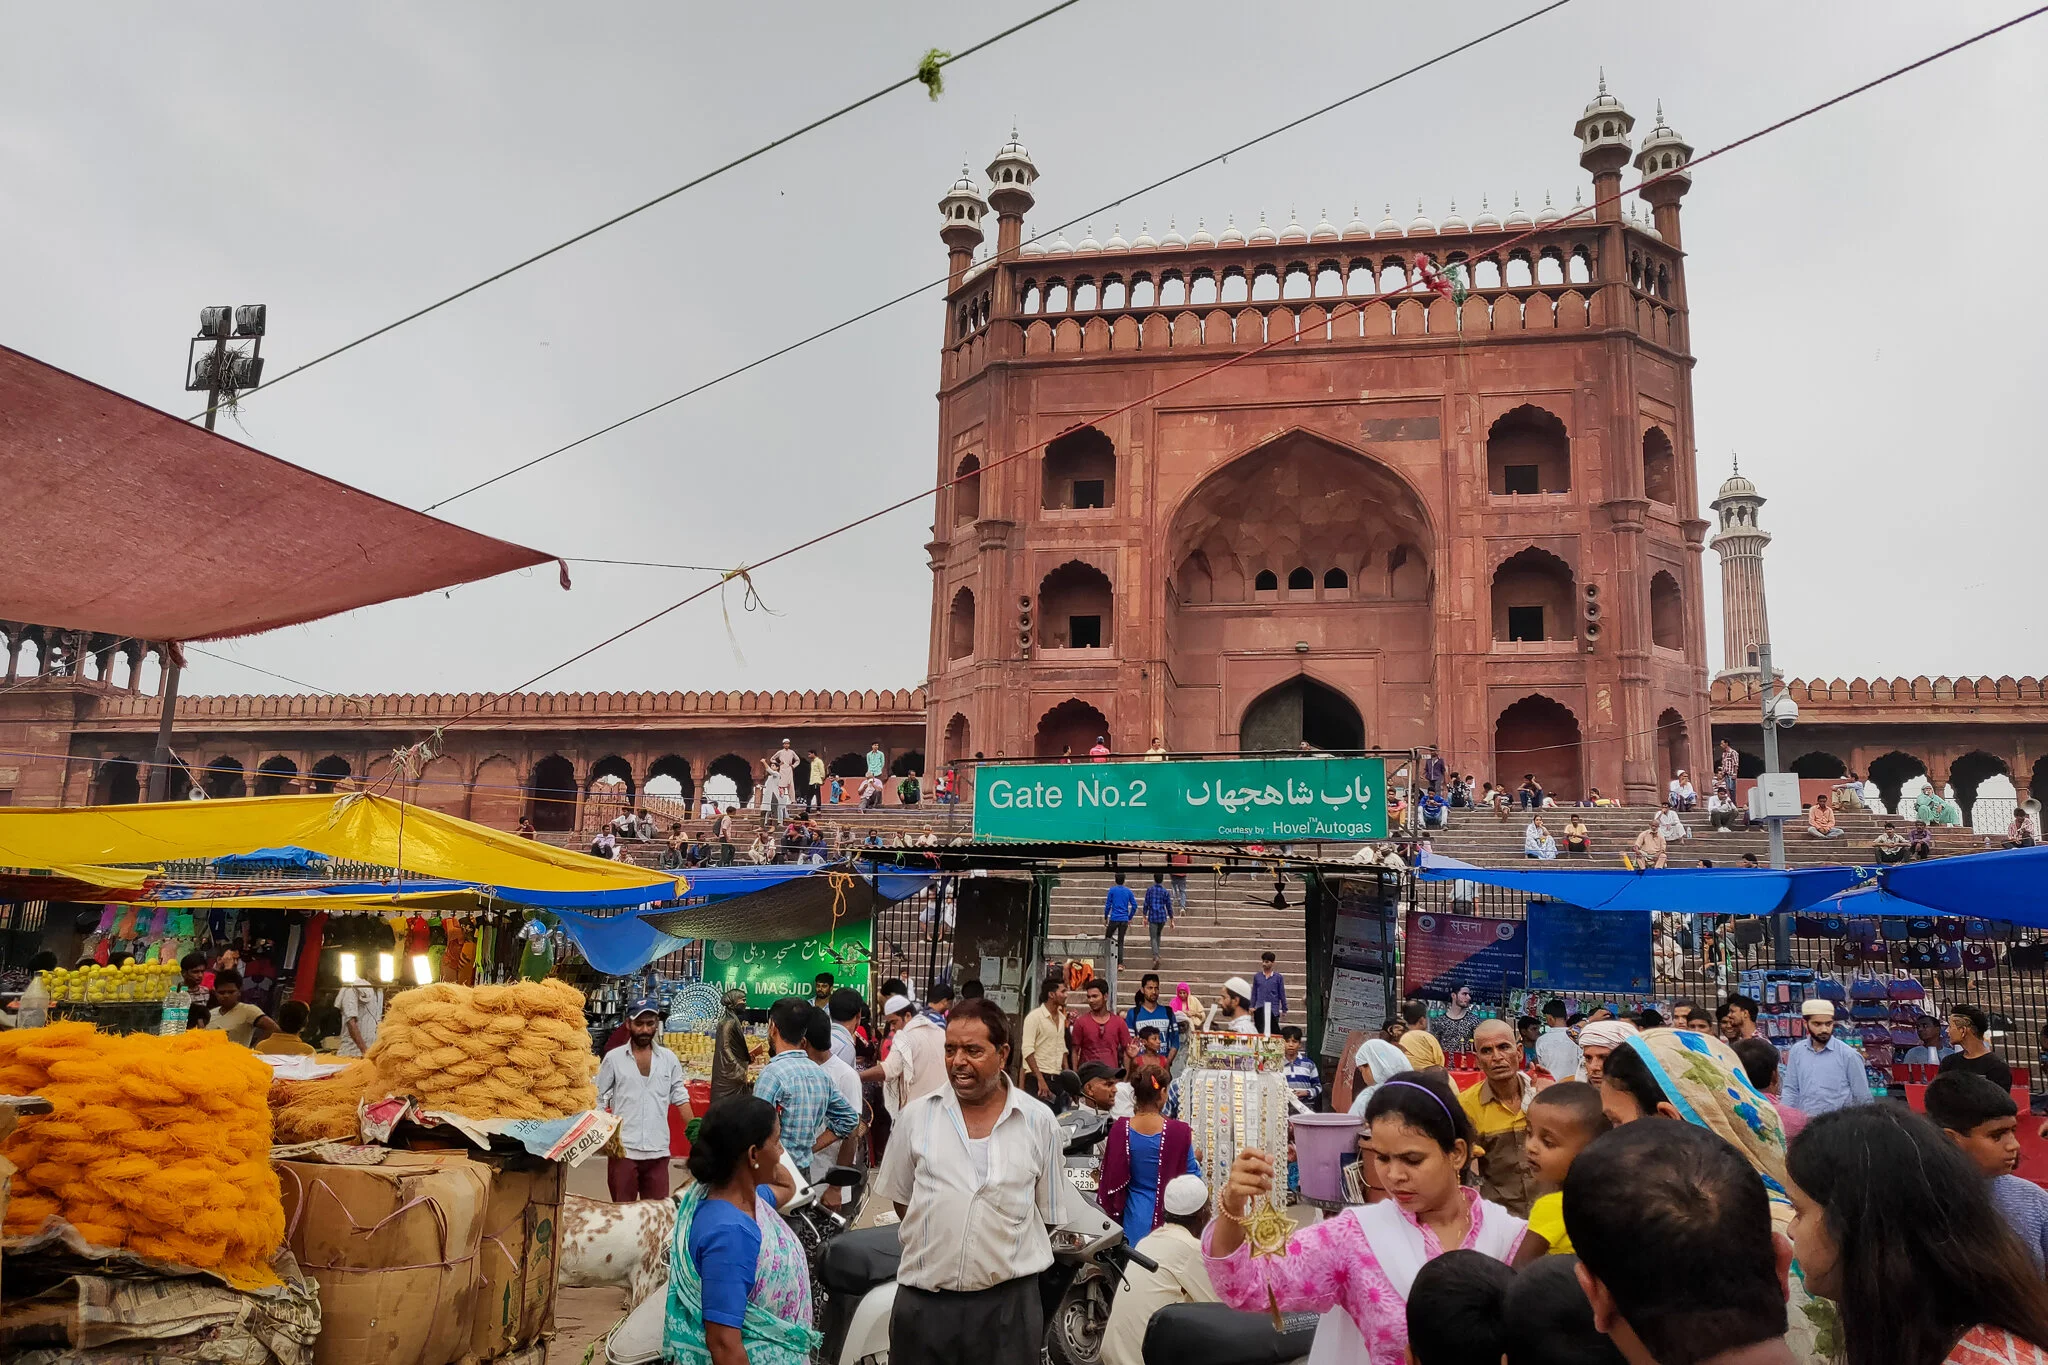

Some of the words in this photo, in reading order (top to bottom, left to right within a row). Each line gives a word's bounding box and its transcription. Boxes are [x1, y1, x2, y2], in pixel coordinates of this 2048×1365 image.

[989, 780, 1063, 808] Gate
[1077, 780, 1147, 808] No.2
[1320, 776, 1372, 811] باب
[1218, 826, 1252, 835] Courtesy
[1254, 826, 1265, 835] by
[1272, 821, 1310, 834] Hovel
[1315, 821, 1372, 836] Autogas
[1450, 920, 1482, 935] सूचना
[709, 980, 748, 994] AMA
[755, 982, 813, 995] MASJID
[1075, 1181, 1095, 1189] 5236
